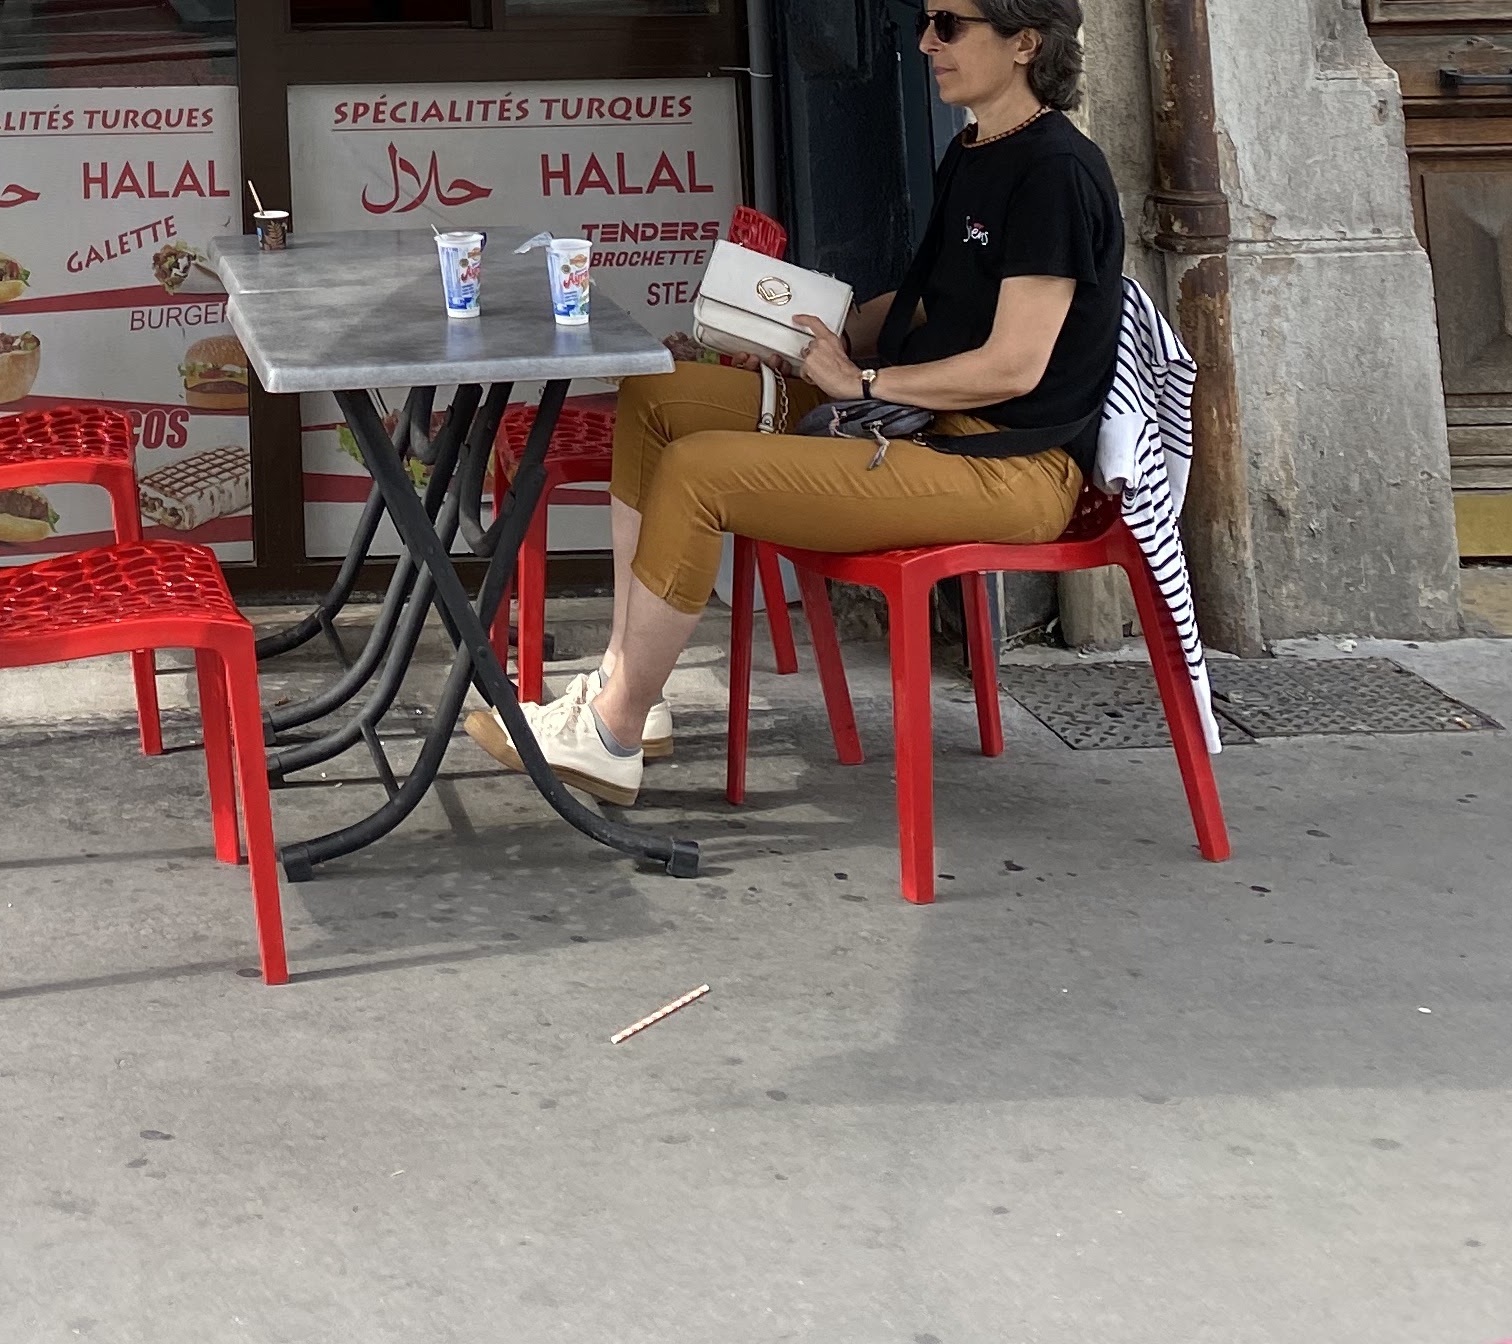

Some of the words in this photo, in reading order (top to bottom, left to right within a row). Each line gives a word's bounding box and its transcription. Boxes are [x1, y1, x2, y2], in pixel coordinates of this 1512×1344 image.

[82, 107, 215, 131] TURQUES
[333, 92, 530, 125] SPÉCIALITÉS
[540, 94, 694, 121] TURQUES
[82, 159, 231, 200] HALAL
[361, 140, 494, 215] حلال
[541, 149, 715, 197] HALAL
[66, 214, 178, 274] GALETTE
[581, 220, 720, 244] TENDERS
[589, 249, 706, 268] BROCHETTE
